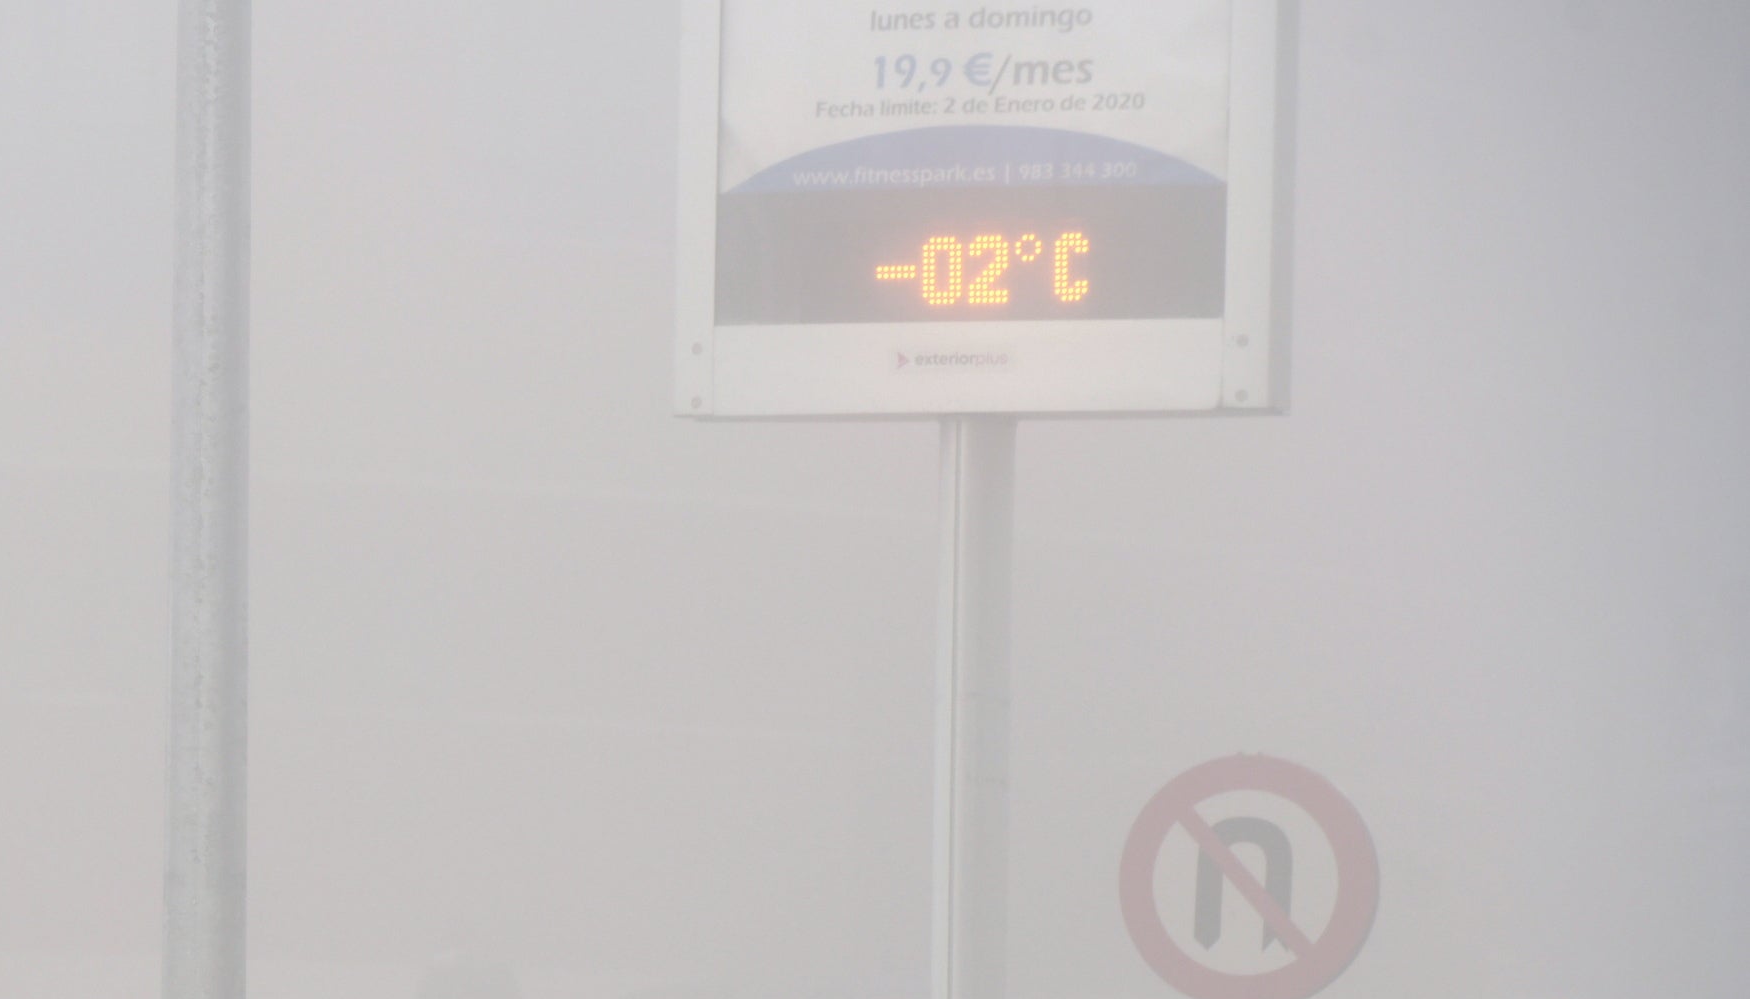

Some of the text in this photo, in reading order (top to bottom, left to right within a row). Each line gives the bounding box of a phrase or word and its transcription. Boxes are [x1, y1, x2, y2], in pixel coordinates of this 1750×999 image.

[870, 6, 1094, 33] lunes a domingo
[873, 51, 1094, 95] 19,9 €/mes
[815, 100, 875, 118] Fecha
[943, 97, 956, 114] 2
[962, 96, 987, 114] de
[994, 94, 1055, 113] Enero
[1059, 93, 1087, 112] de
[1092, 92, 1146, 110] 2020
[793, 164, 996, 187] www.fitnesspark.es
[1018, 163, 1053, 180] 983
[1102, 161, 1137, 179] 300
